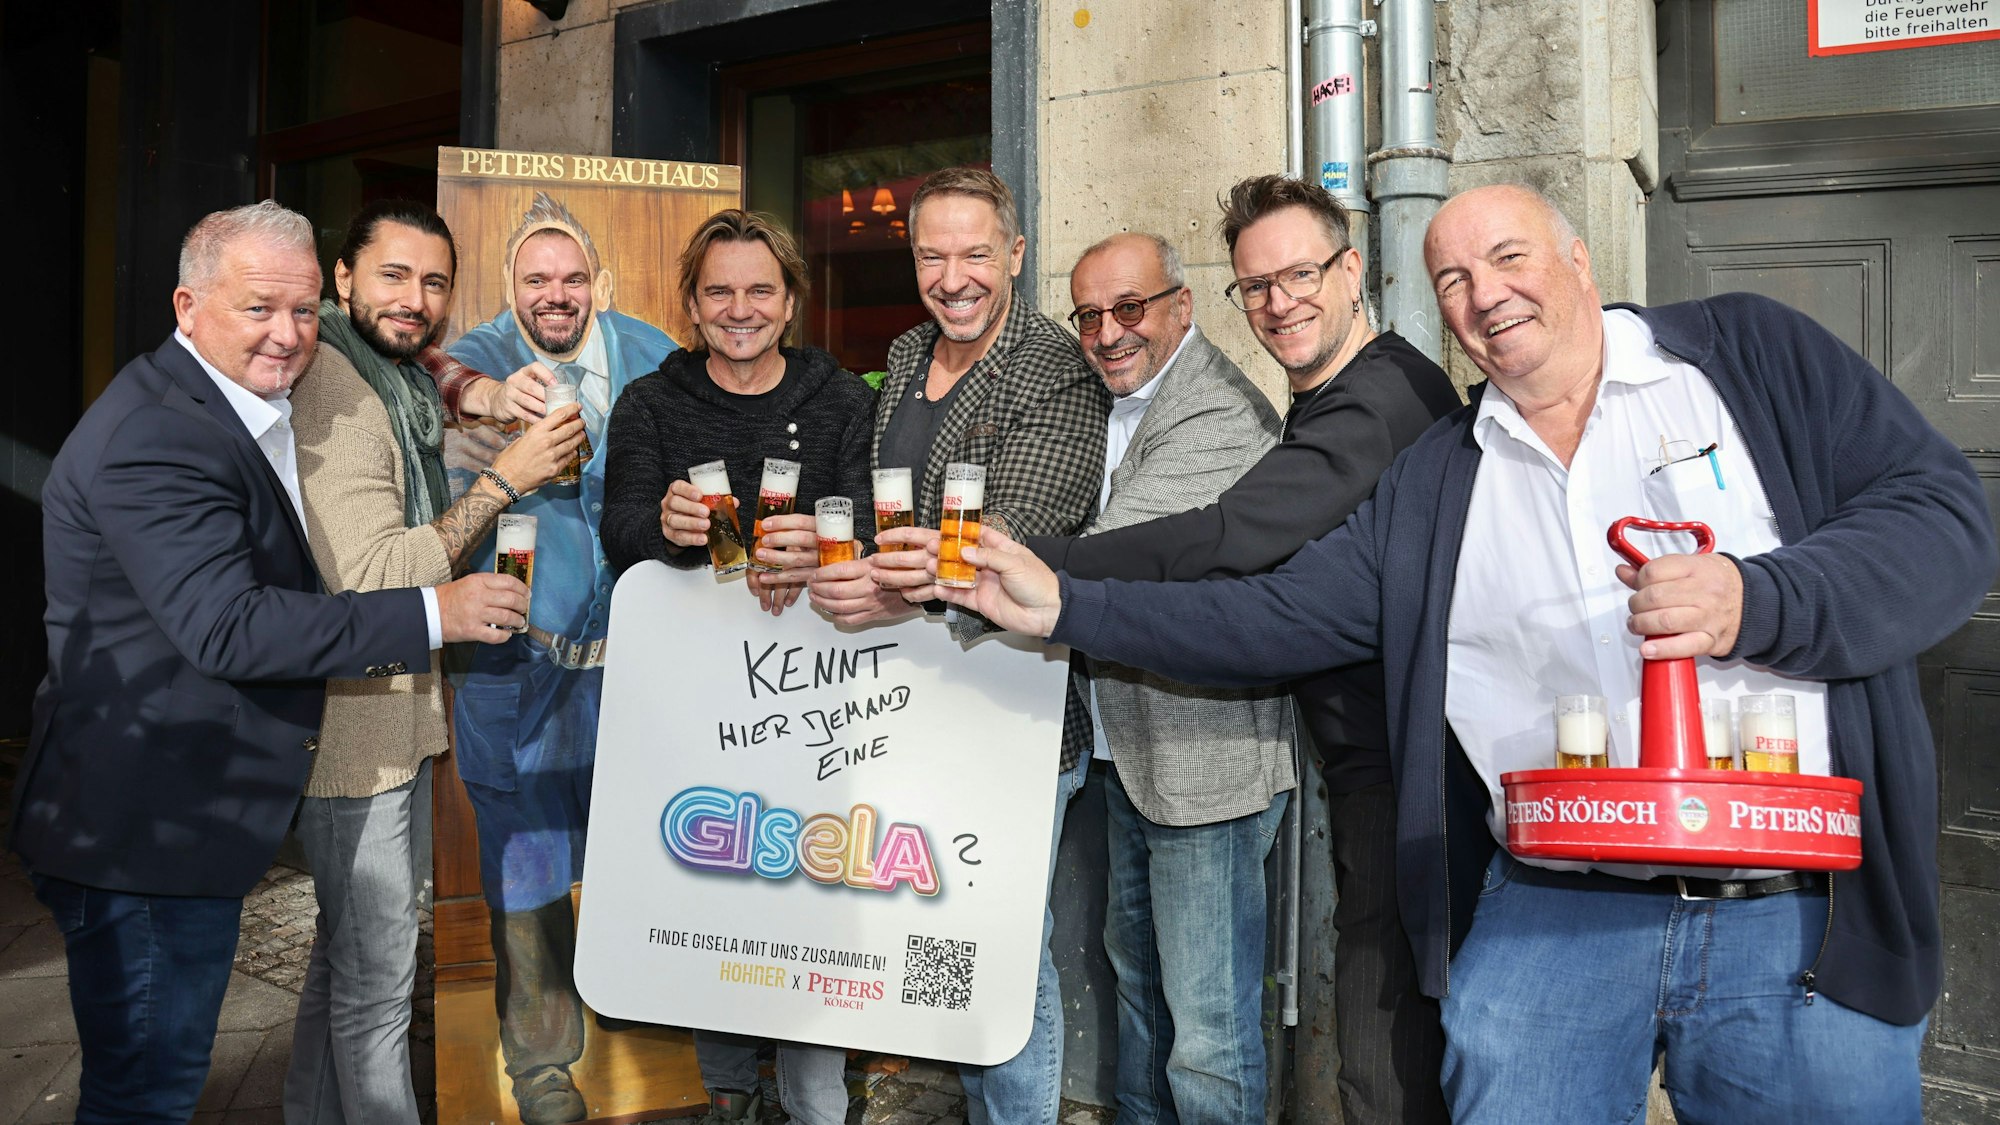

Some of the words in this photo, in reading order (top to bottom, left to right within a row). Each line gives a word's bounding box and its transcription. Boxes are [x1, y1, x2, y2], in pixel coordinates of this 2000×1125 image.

[1865, 11, 1888, 23] die
[1895, 1, 1988, 20] Feuerwehr
[1865, 27, 1900, 39] bitte
[1907, 18, 1988, 35] freihalten
[461, 150, 564, 179] PETERS
[572, 156, 719, 188] BRAUHAUS
[743, 640, 898, 699] KENNT
[718, 714, 791, 751] HIER
[801, 685, 911, 747] JEMAND
[817, 735, 889, 781] EINE
[1508, 796, 1554, 824] PETERS
[1558, 795, 1659, 825] KÖLSCH
[1728, 800, 1824, 835] PETERS
[649, 928, 688, 947] FINDE
[692, 934, 738, 954] GISELA
[742, 940, 767, 957] MIT
[771, 944, 798, 961] UNS
[802, 947, 887, 971] ZUSAMMEN!
[807, 972, 884, 1001] PETERS
[824, 997, 864, 1011] KÖLSCH
